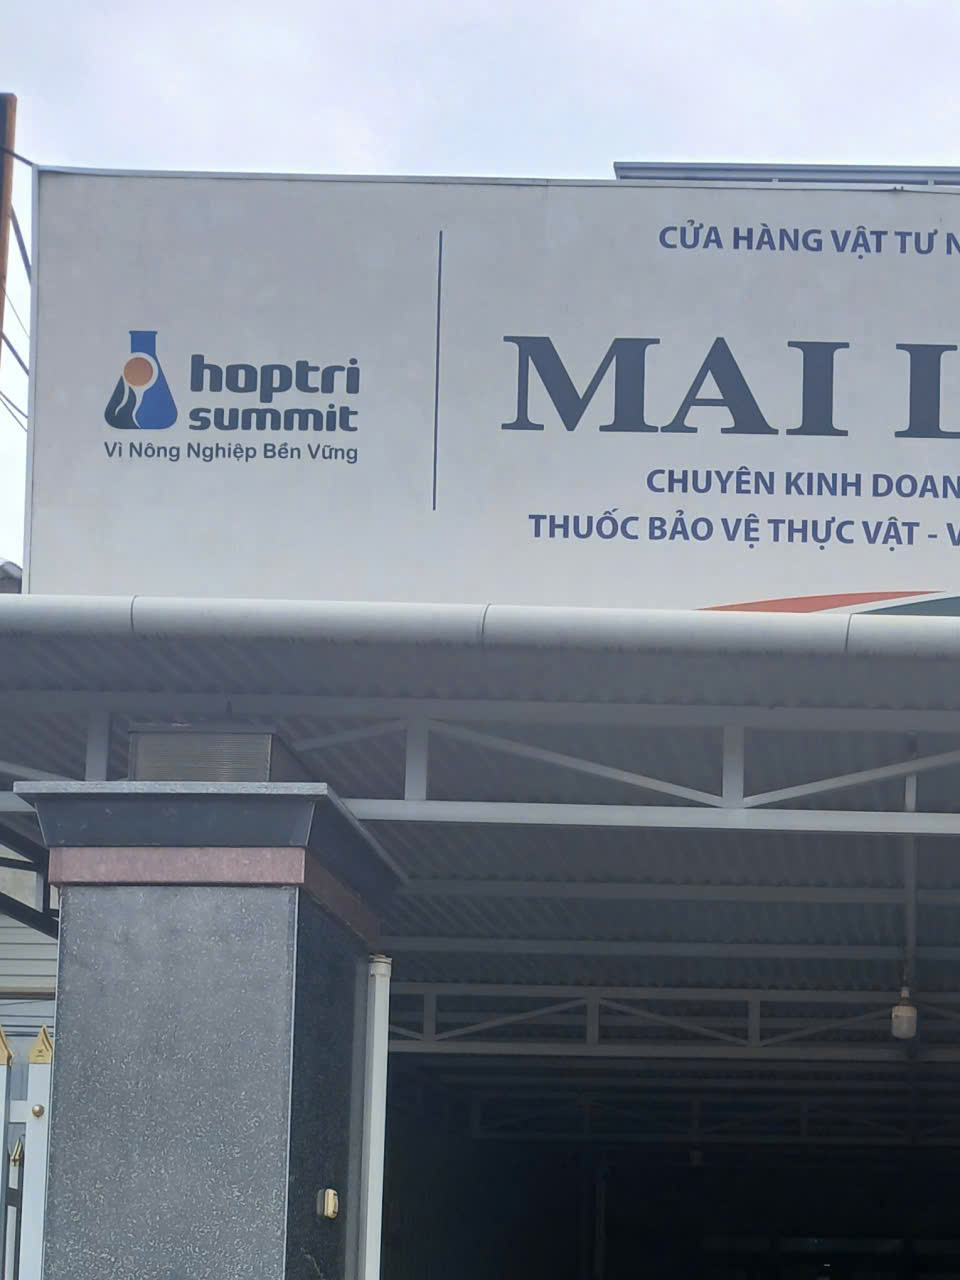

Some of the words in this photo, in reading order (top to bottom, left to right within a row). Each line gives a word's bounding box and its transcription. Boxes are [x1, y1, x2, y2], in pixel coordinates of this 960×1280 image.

[658, 221, 723, 250] CỬA
[731, 219, 824, 254] HÀNG
[830, 222, 889, 257] VẬT
[893, 228, 939, 256] TƯ
[190, 354, 360, 402] hoptri
[501, 334, 850, 437] MAI
[188, 403, 359, 432] summit
[103, 441, 125, 460] Vì
[129, 440, 181, 462] Nông
[187, 442, 257, 464] Nghiệp
[263, 440, 301, 460] Bền
[307, 442, 359, 464] Vững
[646, 466, 775, 496] CHUYÊN
[784, 472, 862, 497] KINH
[528, 508, 640, 541] THUỐC
[648, 509, 714, 543] BẢO
[722, 513, 760, 548] VỆ
[767, 517, 854, 549] THỰC
[862, 514, 920, 551] VẬT
